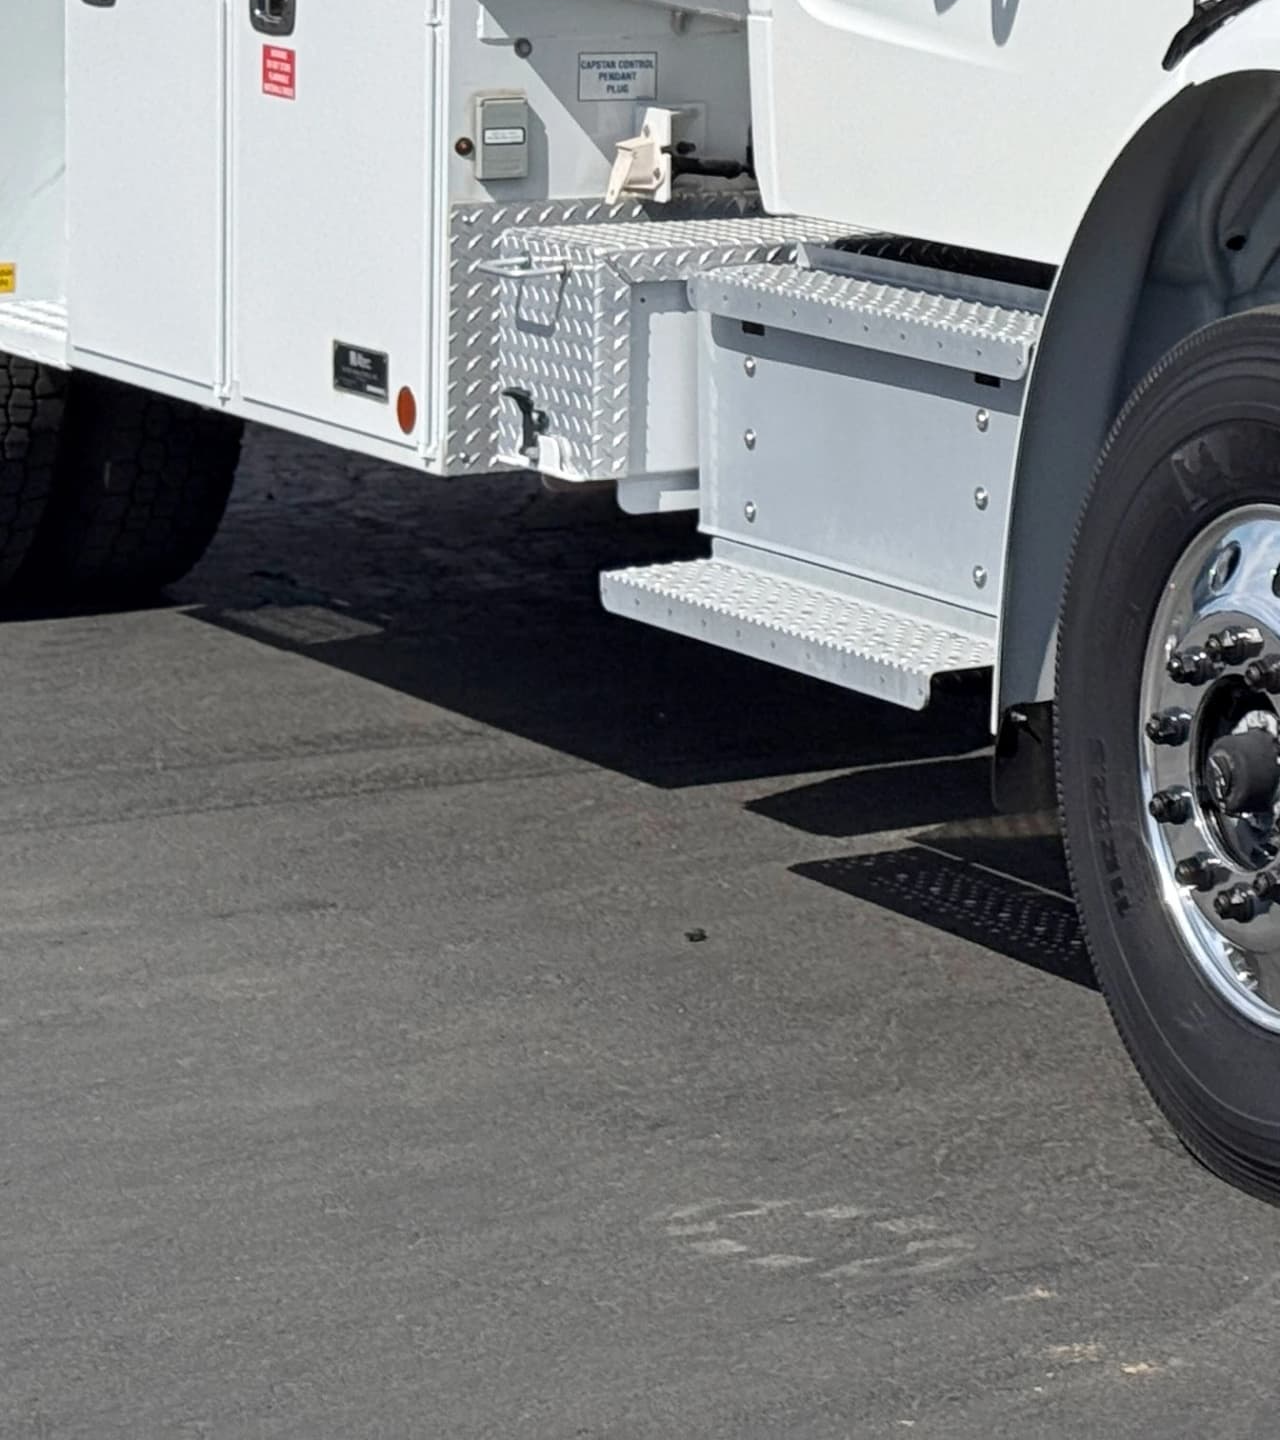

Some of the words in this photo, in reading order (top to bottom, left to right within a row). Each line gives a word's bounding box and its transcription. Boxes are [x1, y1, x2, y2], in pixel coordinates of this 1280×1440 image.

[580, 60, 616, 70] CAPSTAN
[618, 59, 654, 69] CONTROL
[598, 71, 637, 81] PENDANT
[606, 84, 630, 94] PLUG
